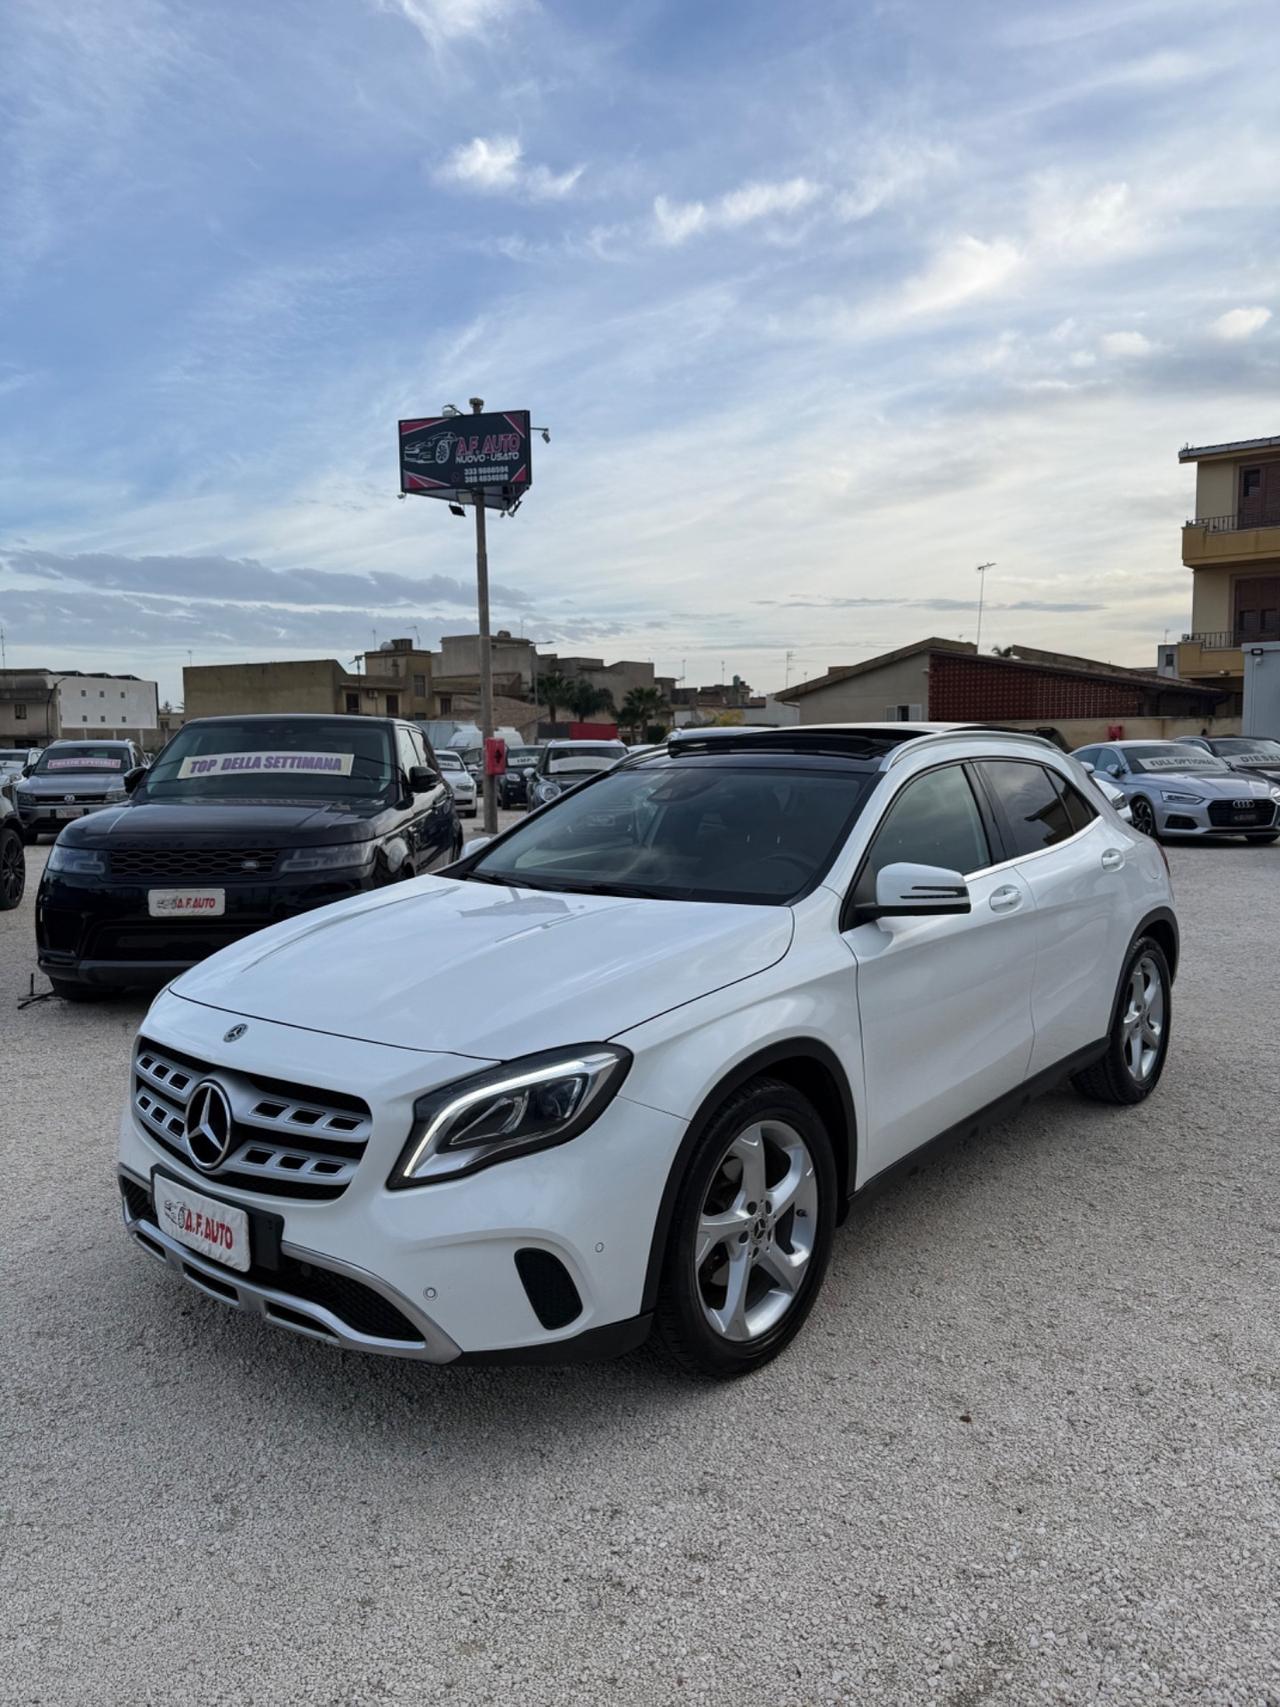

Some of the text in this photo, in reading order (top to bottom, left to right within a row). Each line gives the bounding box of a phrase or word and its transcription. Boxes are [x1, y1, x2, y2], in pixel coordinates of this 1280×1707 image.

[482, 433, 520, 453] AUTO
[455, 455, 486, 464] NUOVO
[491, 452, 520, 460] USATO
[190, 755, 342, 773] TOP DELLA SETTIMANA
[1150, 759, 1174, 767] FULL
